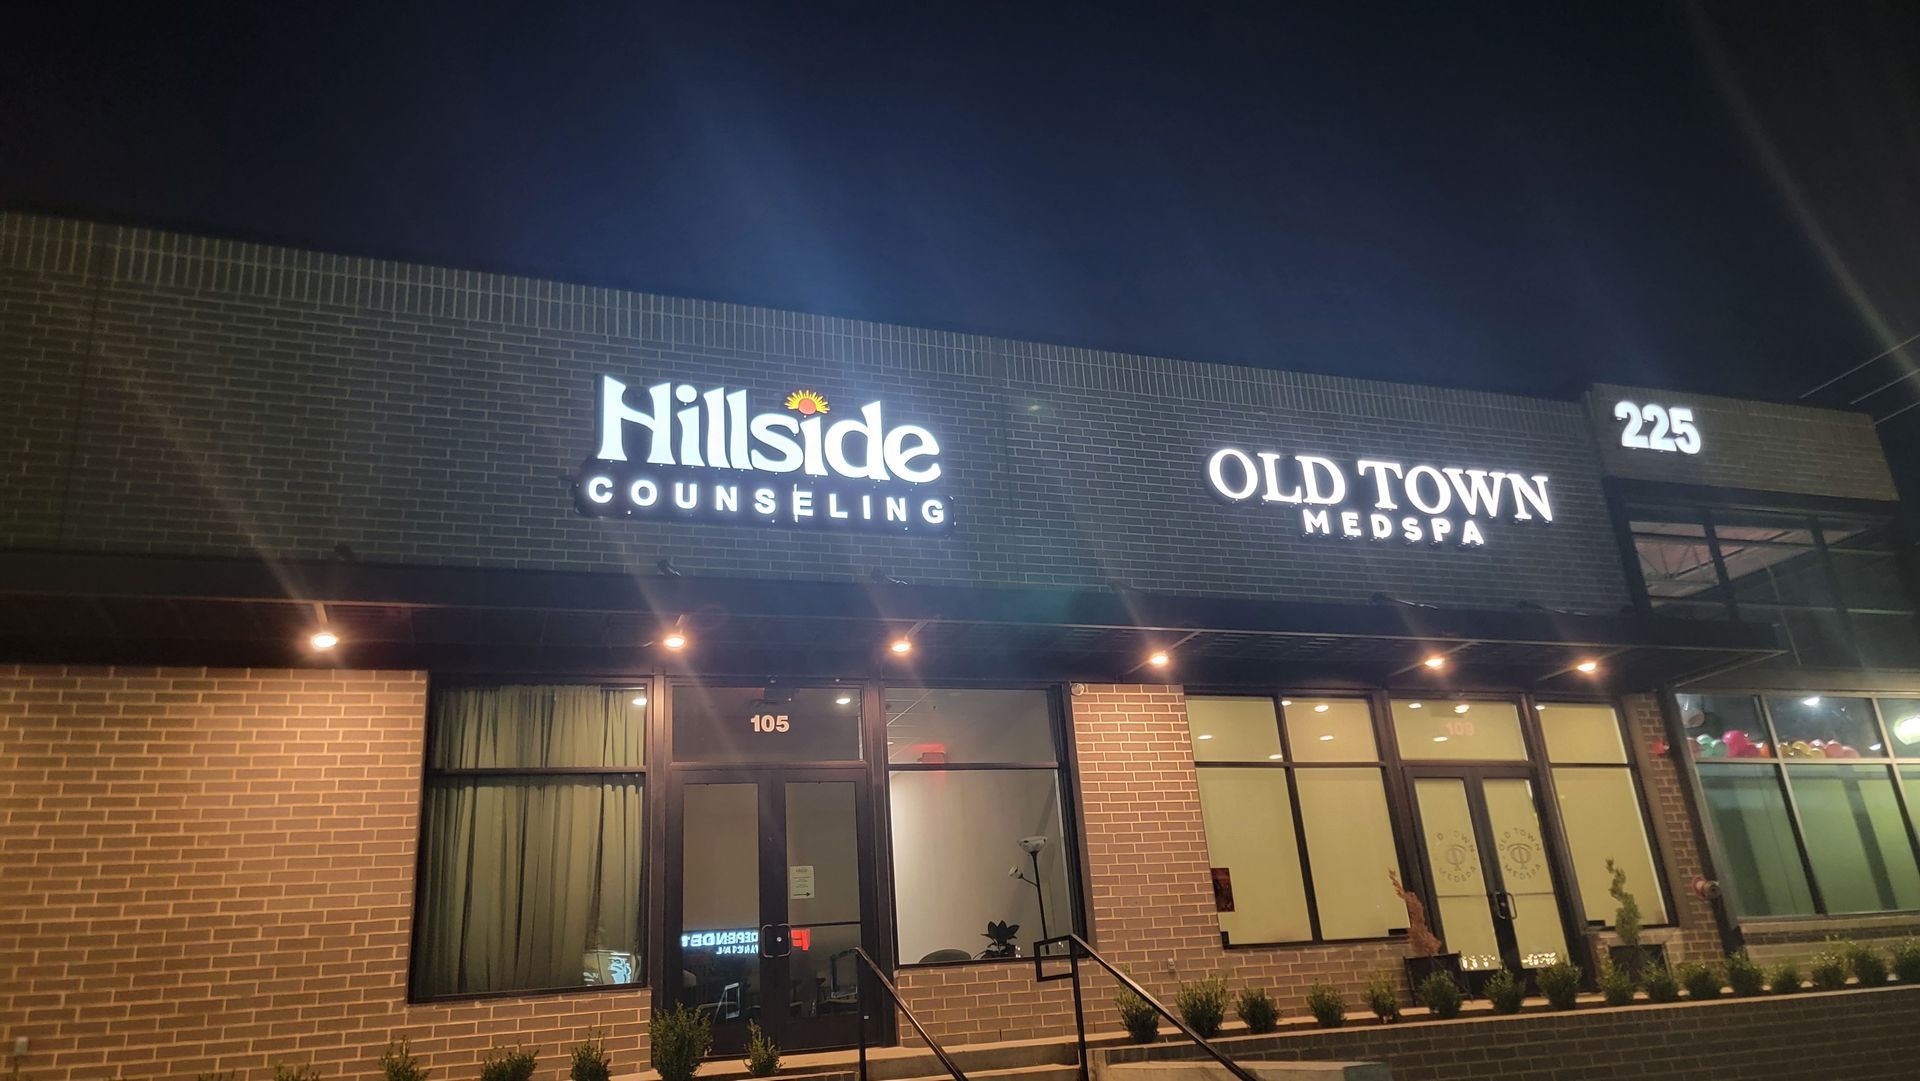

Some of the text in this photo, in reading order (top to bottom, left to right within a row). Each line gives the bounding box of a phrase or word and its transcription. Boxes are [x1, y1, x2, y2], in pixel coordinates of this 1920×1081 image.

[597, 375, 942, 484] Hillside
[1614, 400, 1702, 454] 225
[588, 476, 944, 524] COUNSELING
[1208, 447, 1554, 522] OLD TOWN
[1302, 508, 1484, 545] MEDSPA
[750, 715, 790, 732] 105
[1446, 720, 1473, 736] 109
